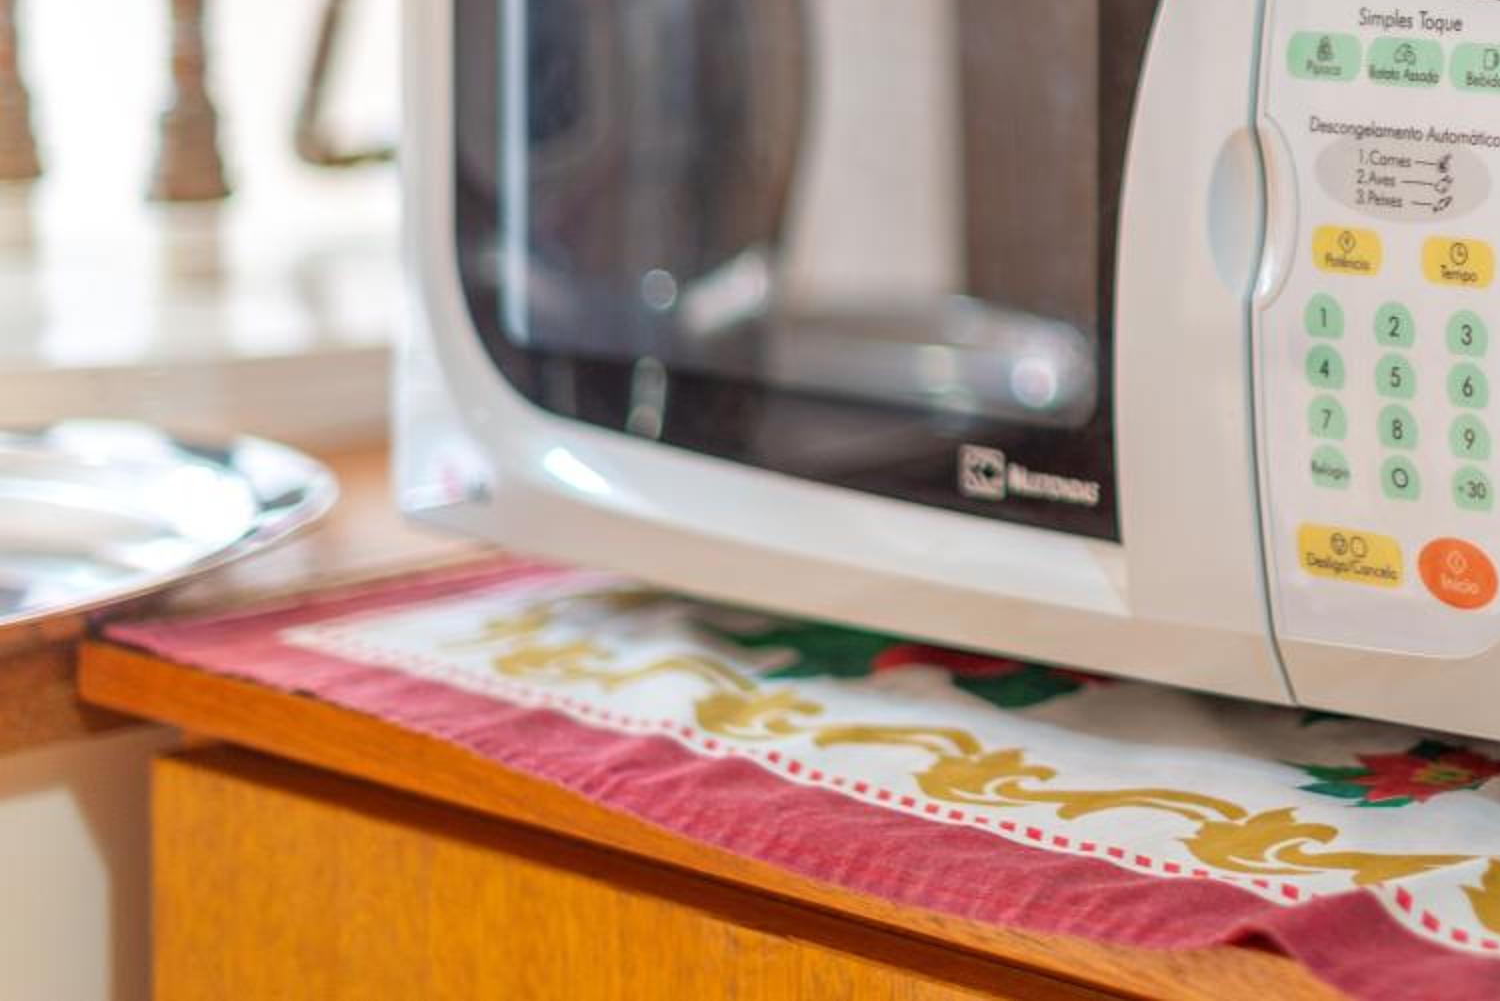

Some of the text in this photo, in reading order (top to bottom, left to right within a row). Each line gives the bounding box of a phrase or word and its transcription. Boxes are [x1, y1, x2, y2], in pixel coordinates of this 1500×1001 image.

[1358, 7, 1463, 35] Simples Toque
[1309, 116, 1422, 142] Descongelamento
[1439, 264, 1478, 283] Tempo
[1320, 307, 1327, 328] 1
[1388, 315, 1400, 338] 2
[1461, 324, 1473, 347] 3
[1319, 359, 1330, 379] 4
[1390, 366, 1402, 388] 5
[1462, 376, 1474, 398] 6
[1321, 409, 1331, 430] 7
[1392, 419, 1403, 440] 8
[1464, 428, 1475, 450] 9
